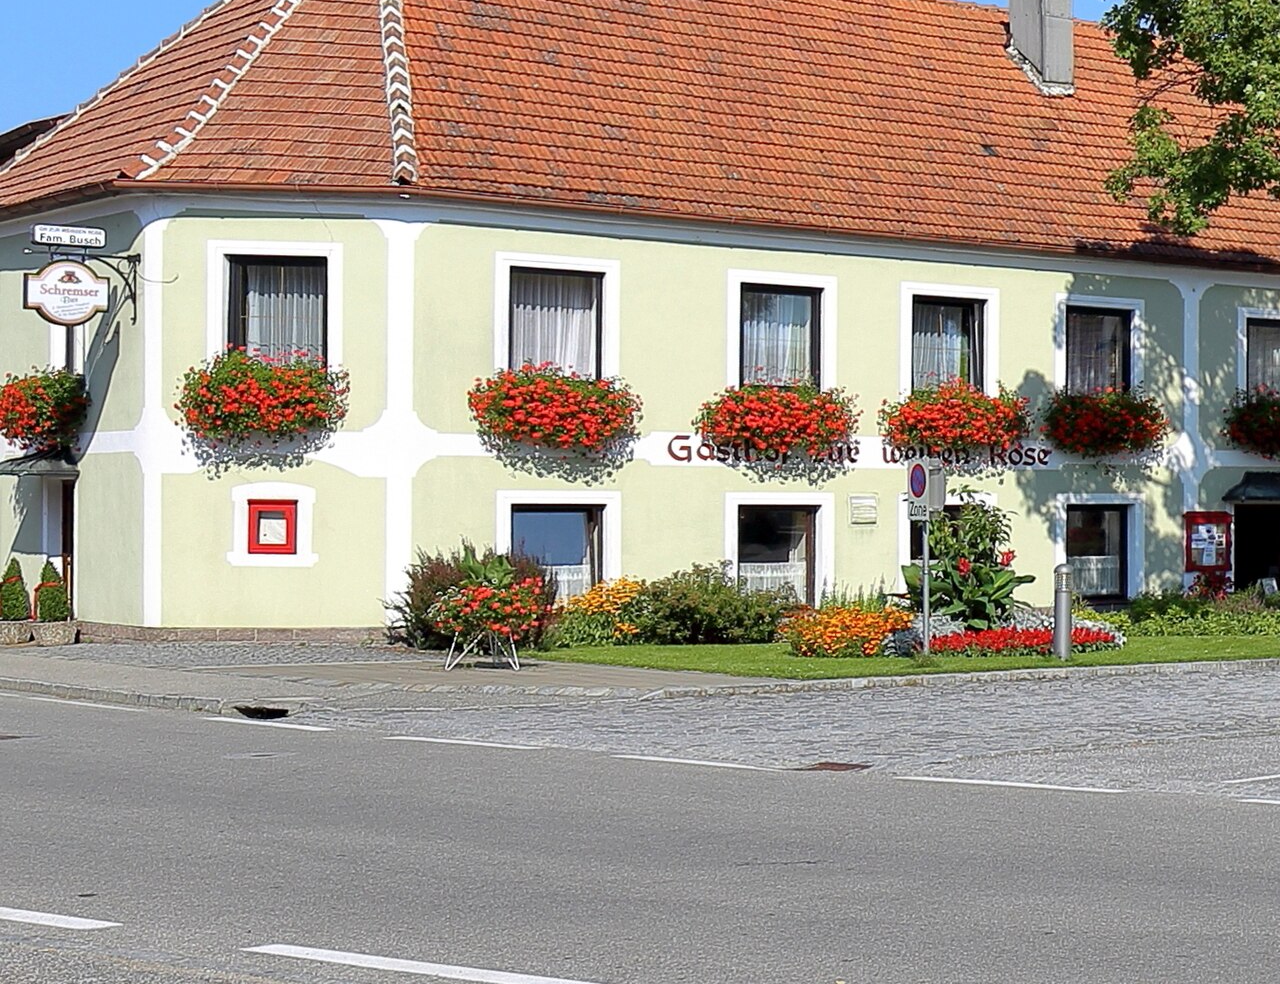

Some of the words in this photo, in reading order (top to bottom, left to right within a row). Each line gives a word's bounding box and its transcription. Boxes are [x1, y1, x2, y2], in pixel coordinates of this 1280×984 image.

[40, 233, 66, 243] Fam.
[70, 235, 102, 245] Busch
[40, 284, 99, 297] Schremser
[882, 445, 971, 465] weien
[910, 501, 928, 517] Zone
